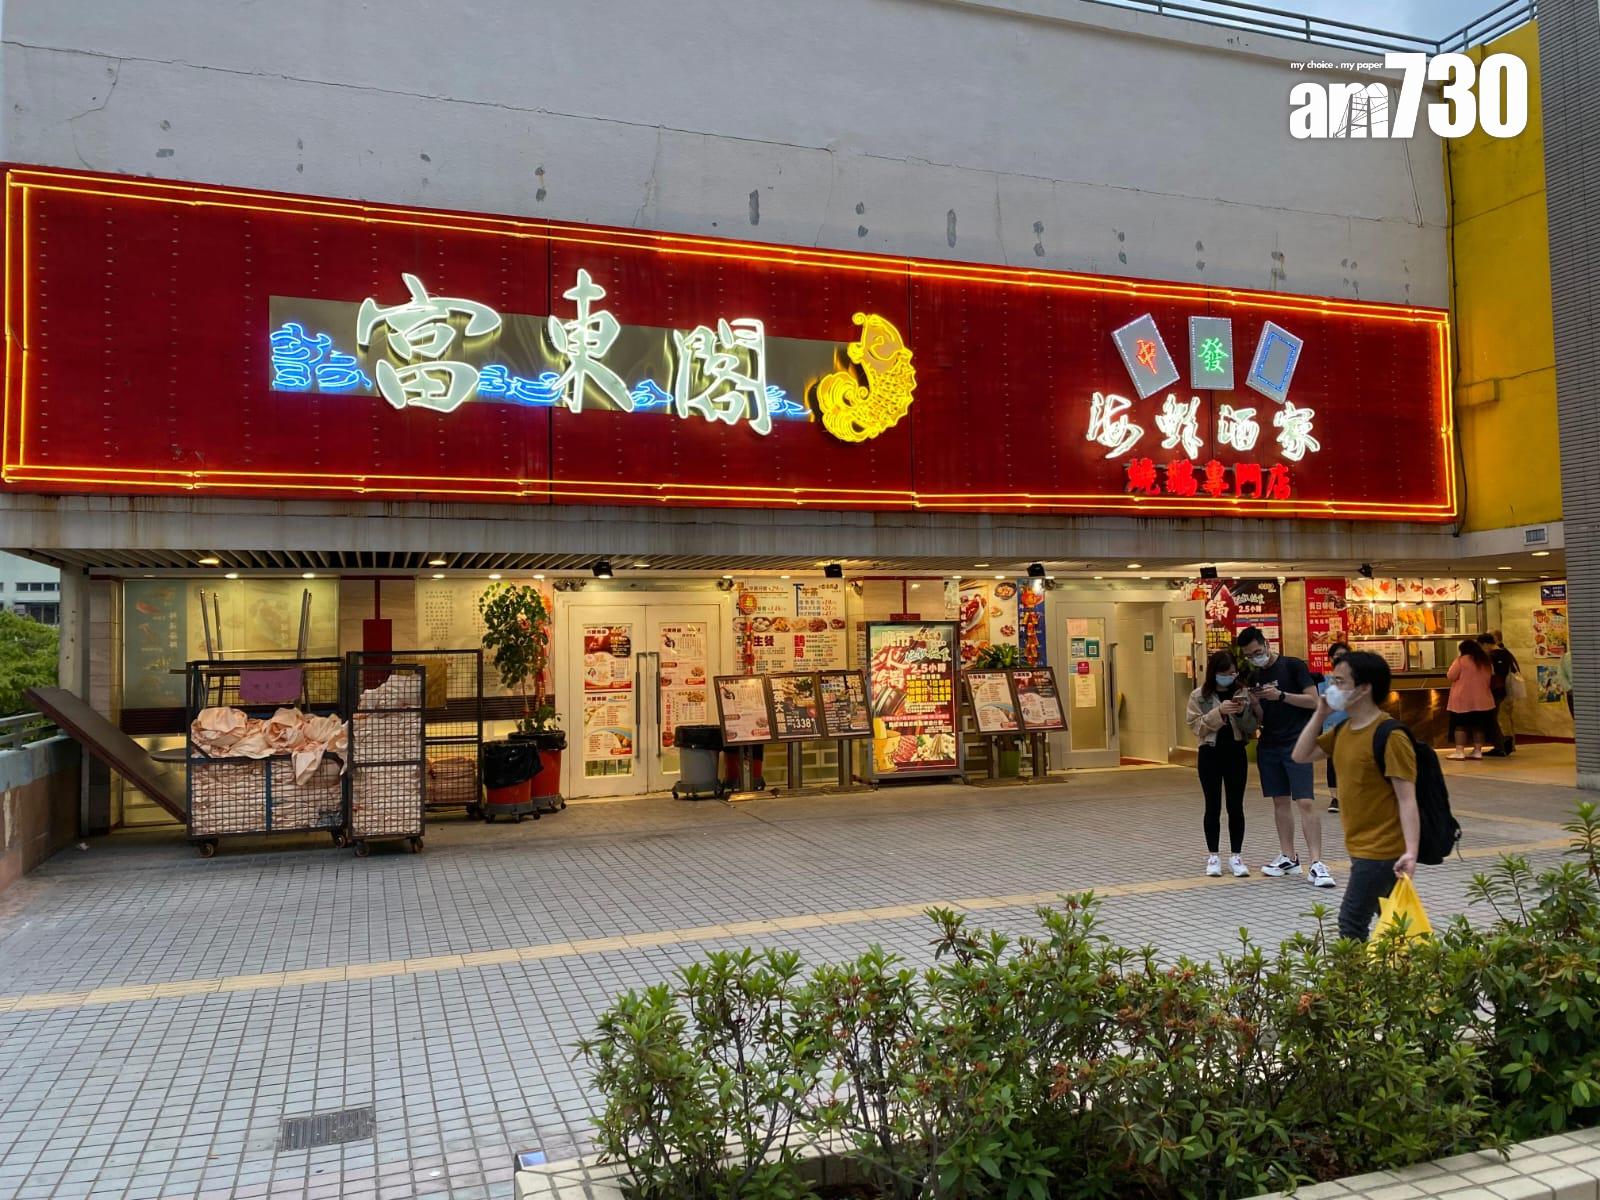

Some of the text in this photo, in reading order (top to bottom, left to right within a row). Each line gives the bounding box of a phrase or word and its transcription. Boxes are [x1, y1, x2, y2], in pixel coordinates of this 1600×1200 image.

[356, 268, 772, 437] 富東閣
[1086, 391, 1321, 462] 海鮮酒家
